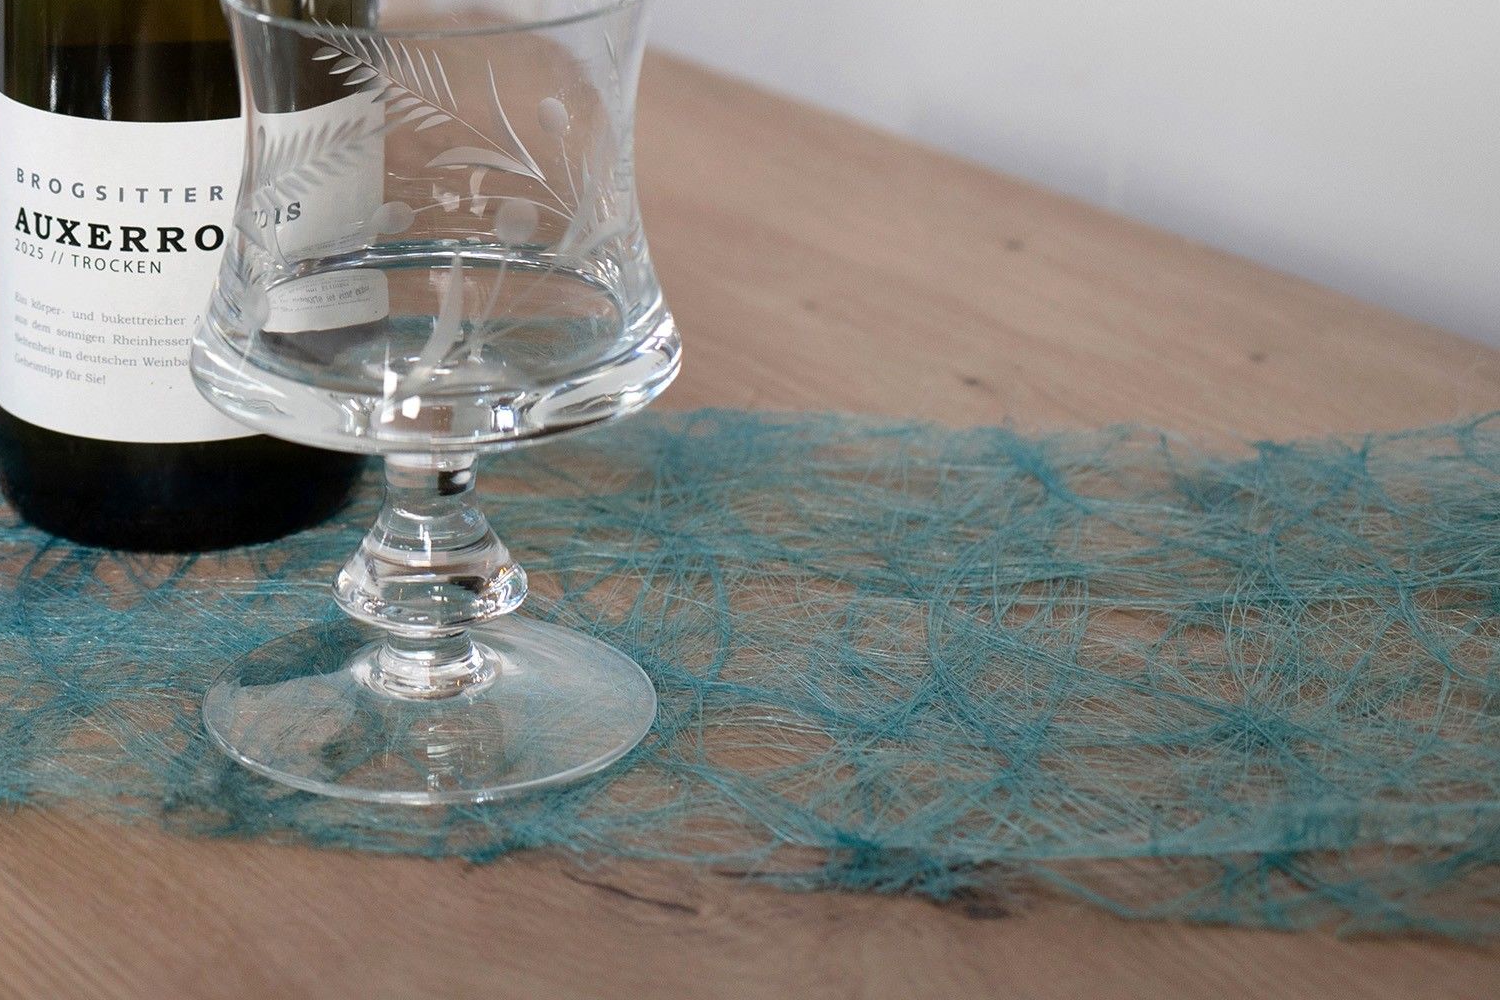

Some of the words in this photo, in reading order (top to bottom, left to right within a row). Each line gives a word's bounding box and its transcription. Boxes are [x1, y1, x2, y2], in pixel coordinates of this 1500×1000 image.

[16, 167, 224, 204] BROGSITTER
[14, 238, 44, 260] 2025
[72, 253, 163, 274] TROCKEN
[72, 311, 95, 321] und
[101, 312, 187, 326] bukettreicher
[31, 319, 51, 334] dem
[56, 328, 106, 344] sonnigen
[58, 348, 73, 360] im
[76, 351, 138, 368] deutschen
[66, 368, 83, 381] für
[85, 372, 106, 385] Sie!
